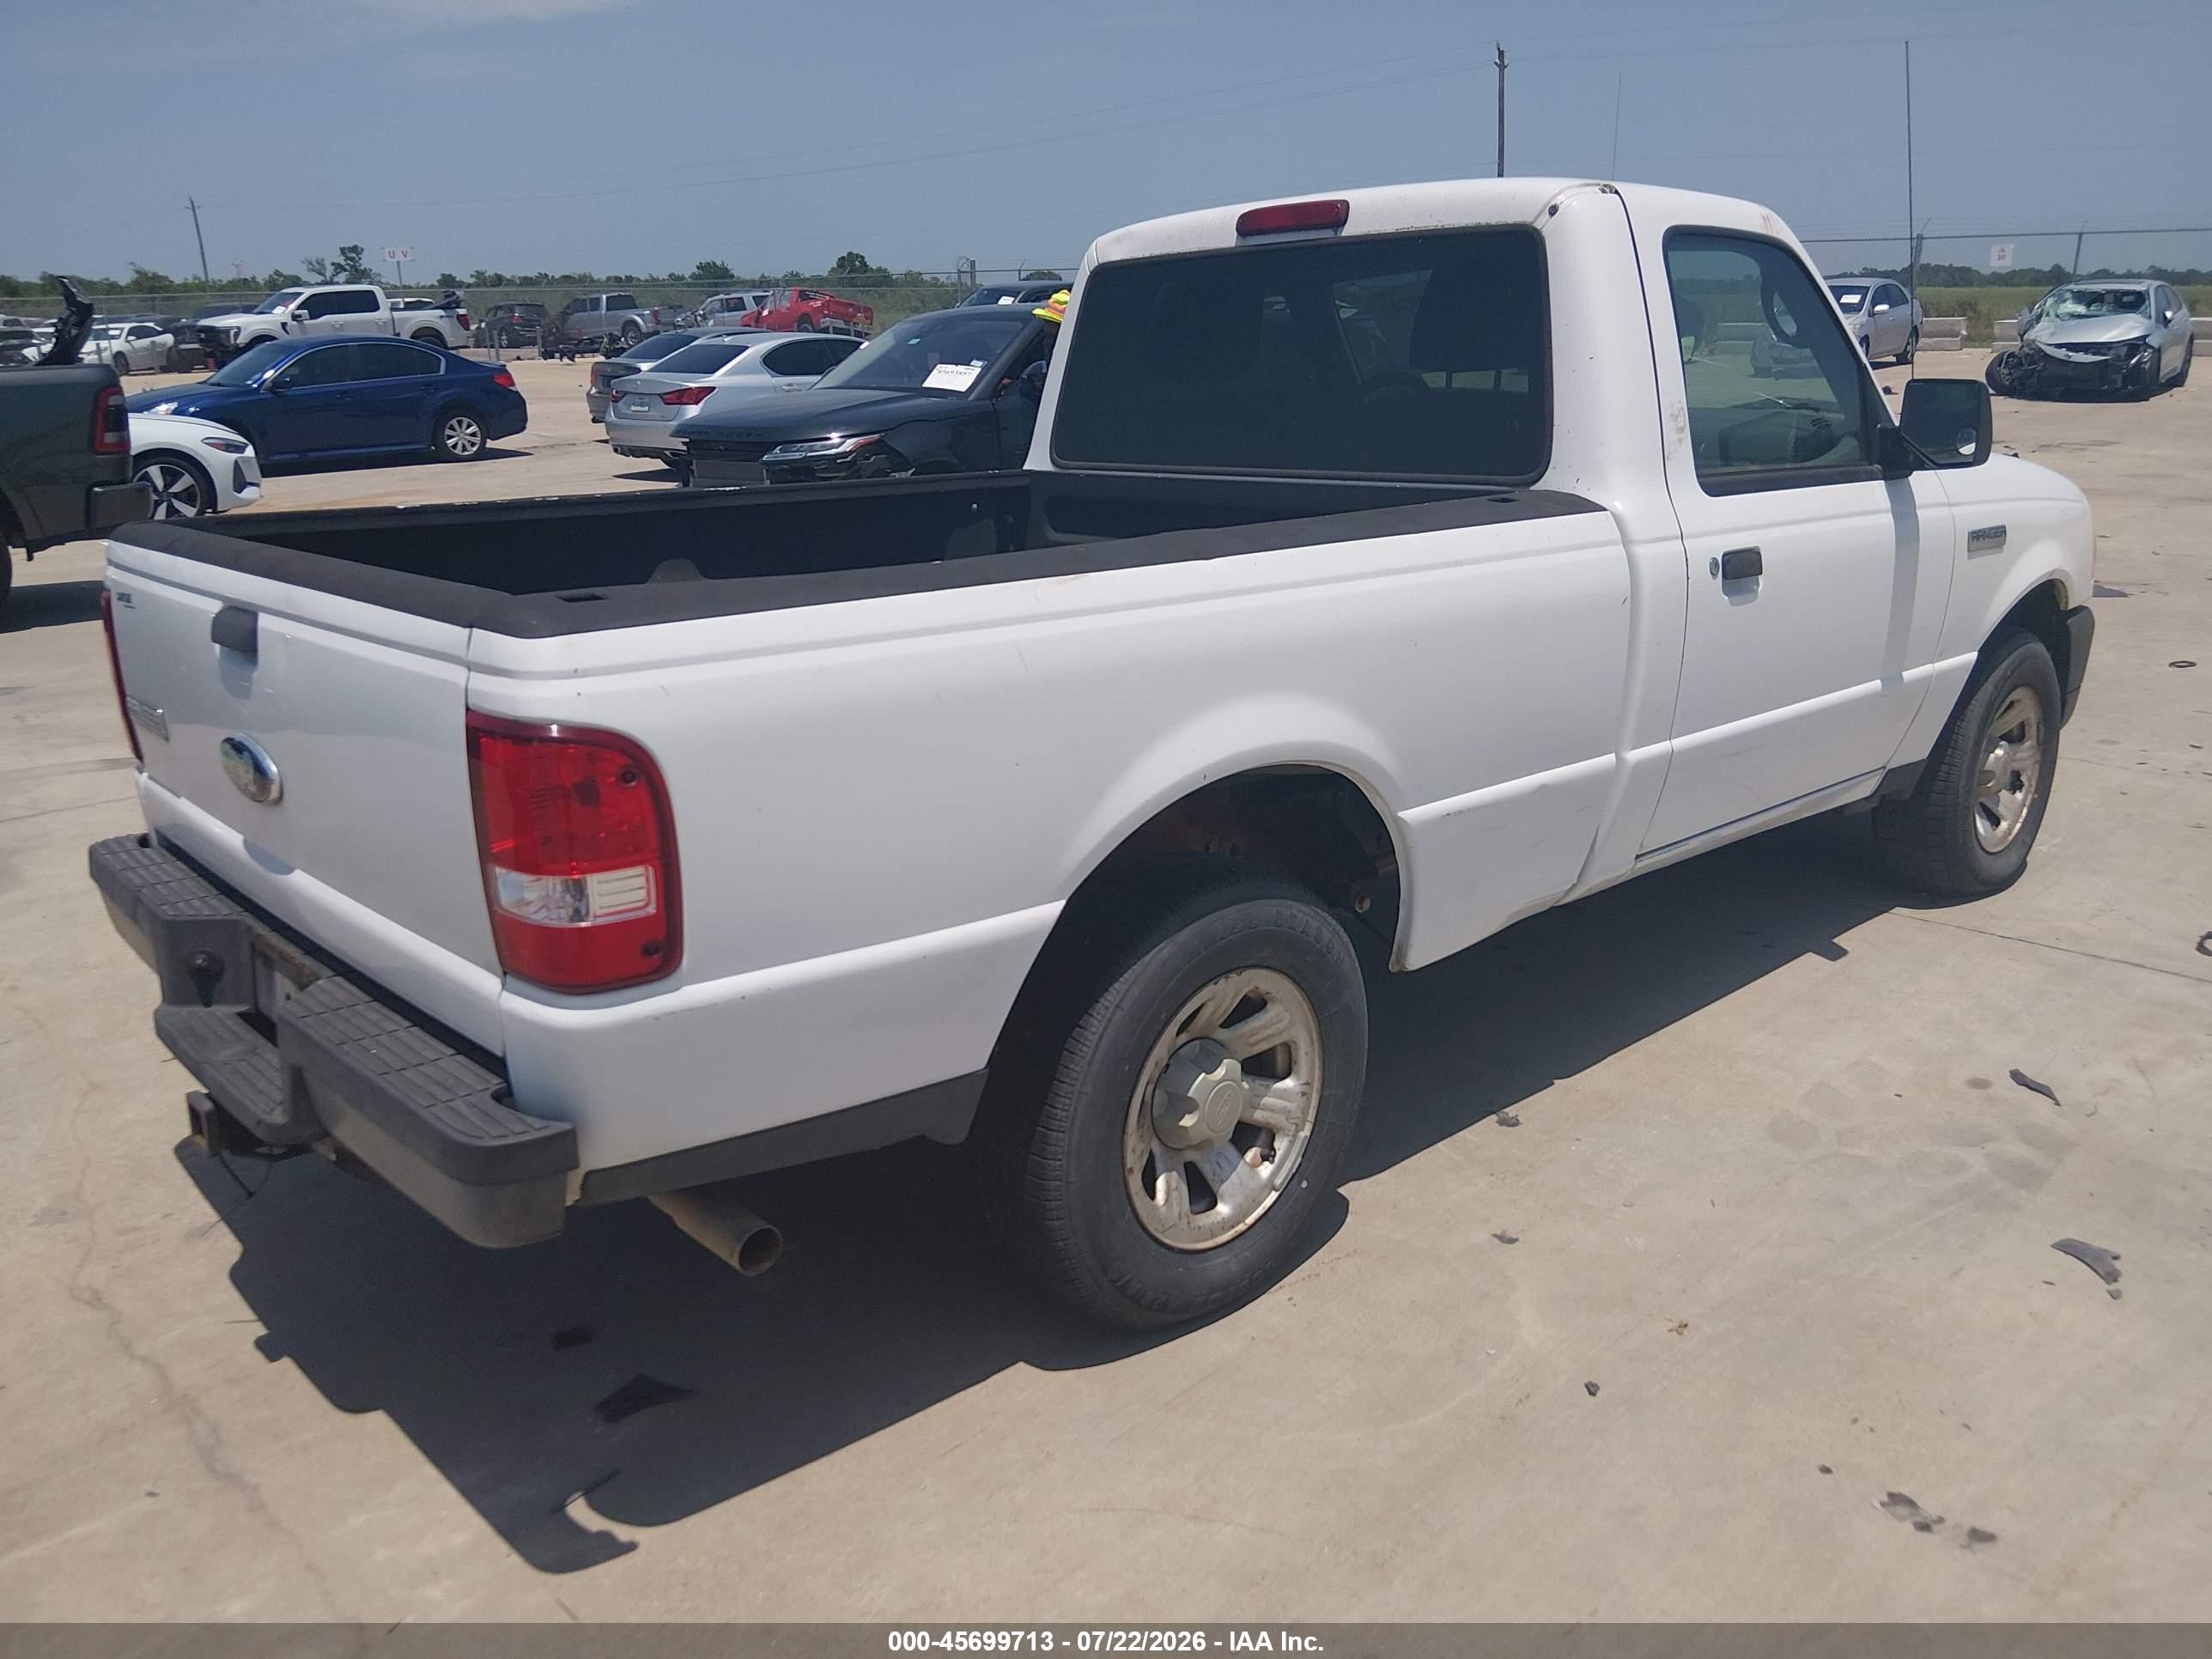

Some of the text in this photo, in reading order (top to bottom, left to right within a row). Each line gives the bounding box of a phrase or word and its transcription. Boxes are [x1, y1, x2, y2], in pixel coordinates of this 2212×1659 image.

[387, 250, 409, 259] U V
[1972, 526, 2007, 543] RANGER
